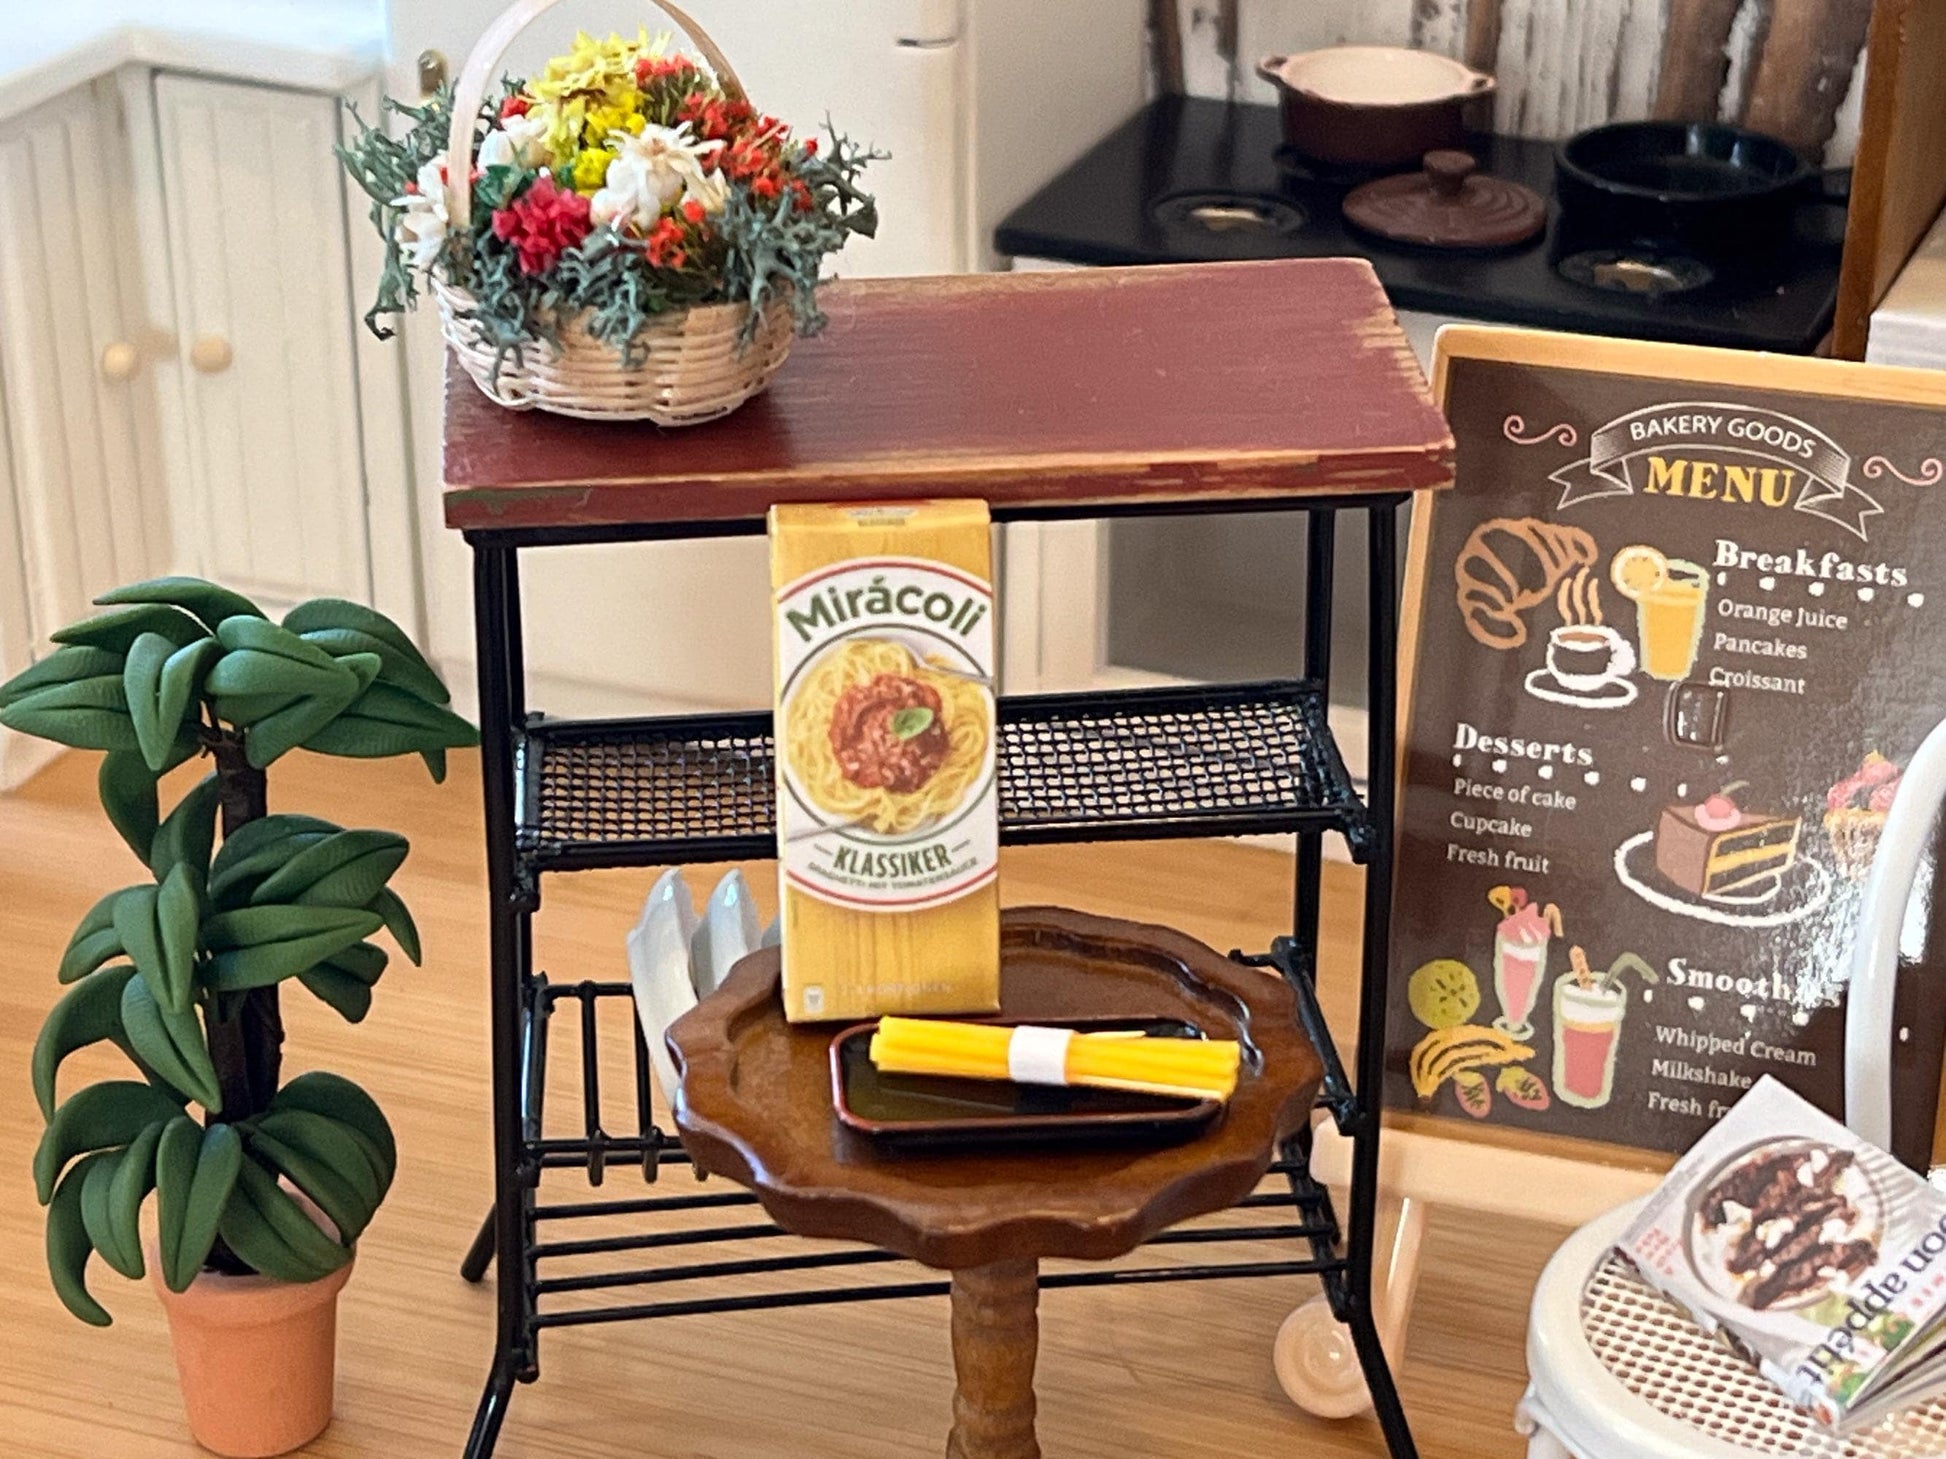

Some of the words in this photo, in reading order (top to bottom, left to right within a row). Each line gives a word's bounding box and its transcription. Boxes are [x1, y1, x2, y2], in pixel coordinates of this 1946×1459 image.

[1630, 415, 1722, 440] BAKERY
[1728, 418, 1817, 458] GOODS
[1643, 456, 1795, 507] MENU
[1712, 539, 1908, 587] Breakfasts
[786, 575, 987, 642] Mirácoli
[1718, 599, 1793, 626] Orange
[1796, 607, 1848, 630] Juice
[1713, 632, 1808, 659] Pancakes
[1709, 666, 1805, 695] Croissant
[1453, 722, 1594, 766] Desserts
[1453, 778, 1504, 800] Piece
[1507, 785, 1531, 803] of
[1532, 790, 1577, 810] cake
[1450, 811, 1533, 837] Cupcake
[833, 844, 952, 878] KLASSIKER
[1447, 843, 1499, 867] Fresh
[1504, 850, 1549, 874] fruit
[1656, 1025, 1746, 1055] Whipped
[1750, 1041, 1816, 1066] Cream
[1651, 1058, 1752, 1089] Milkshake
[1648, 1091, 1702, 1116] Fresh
